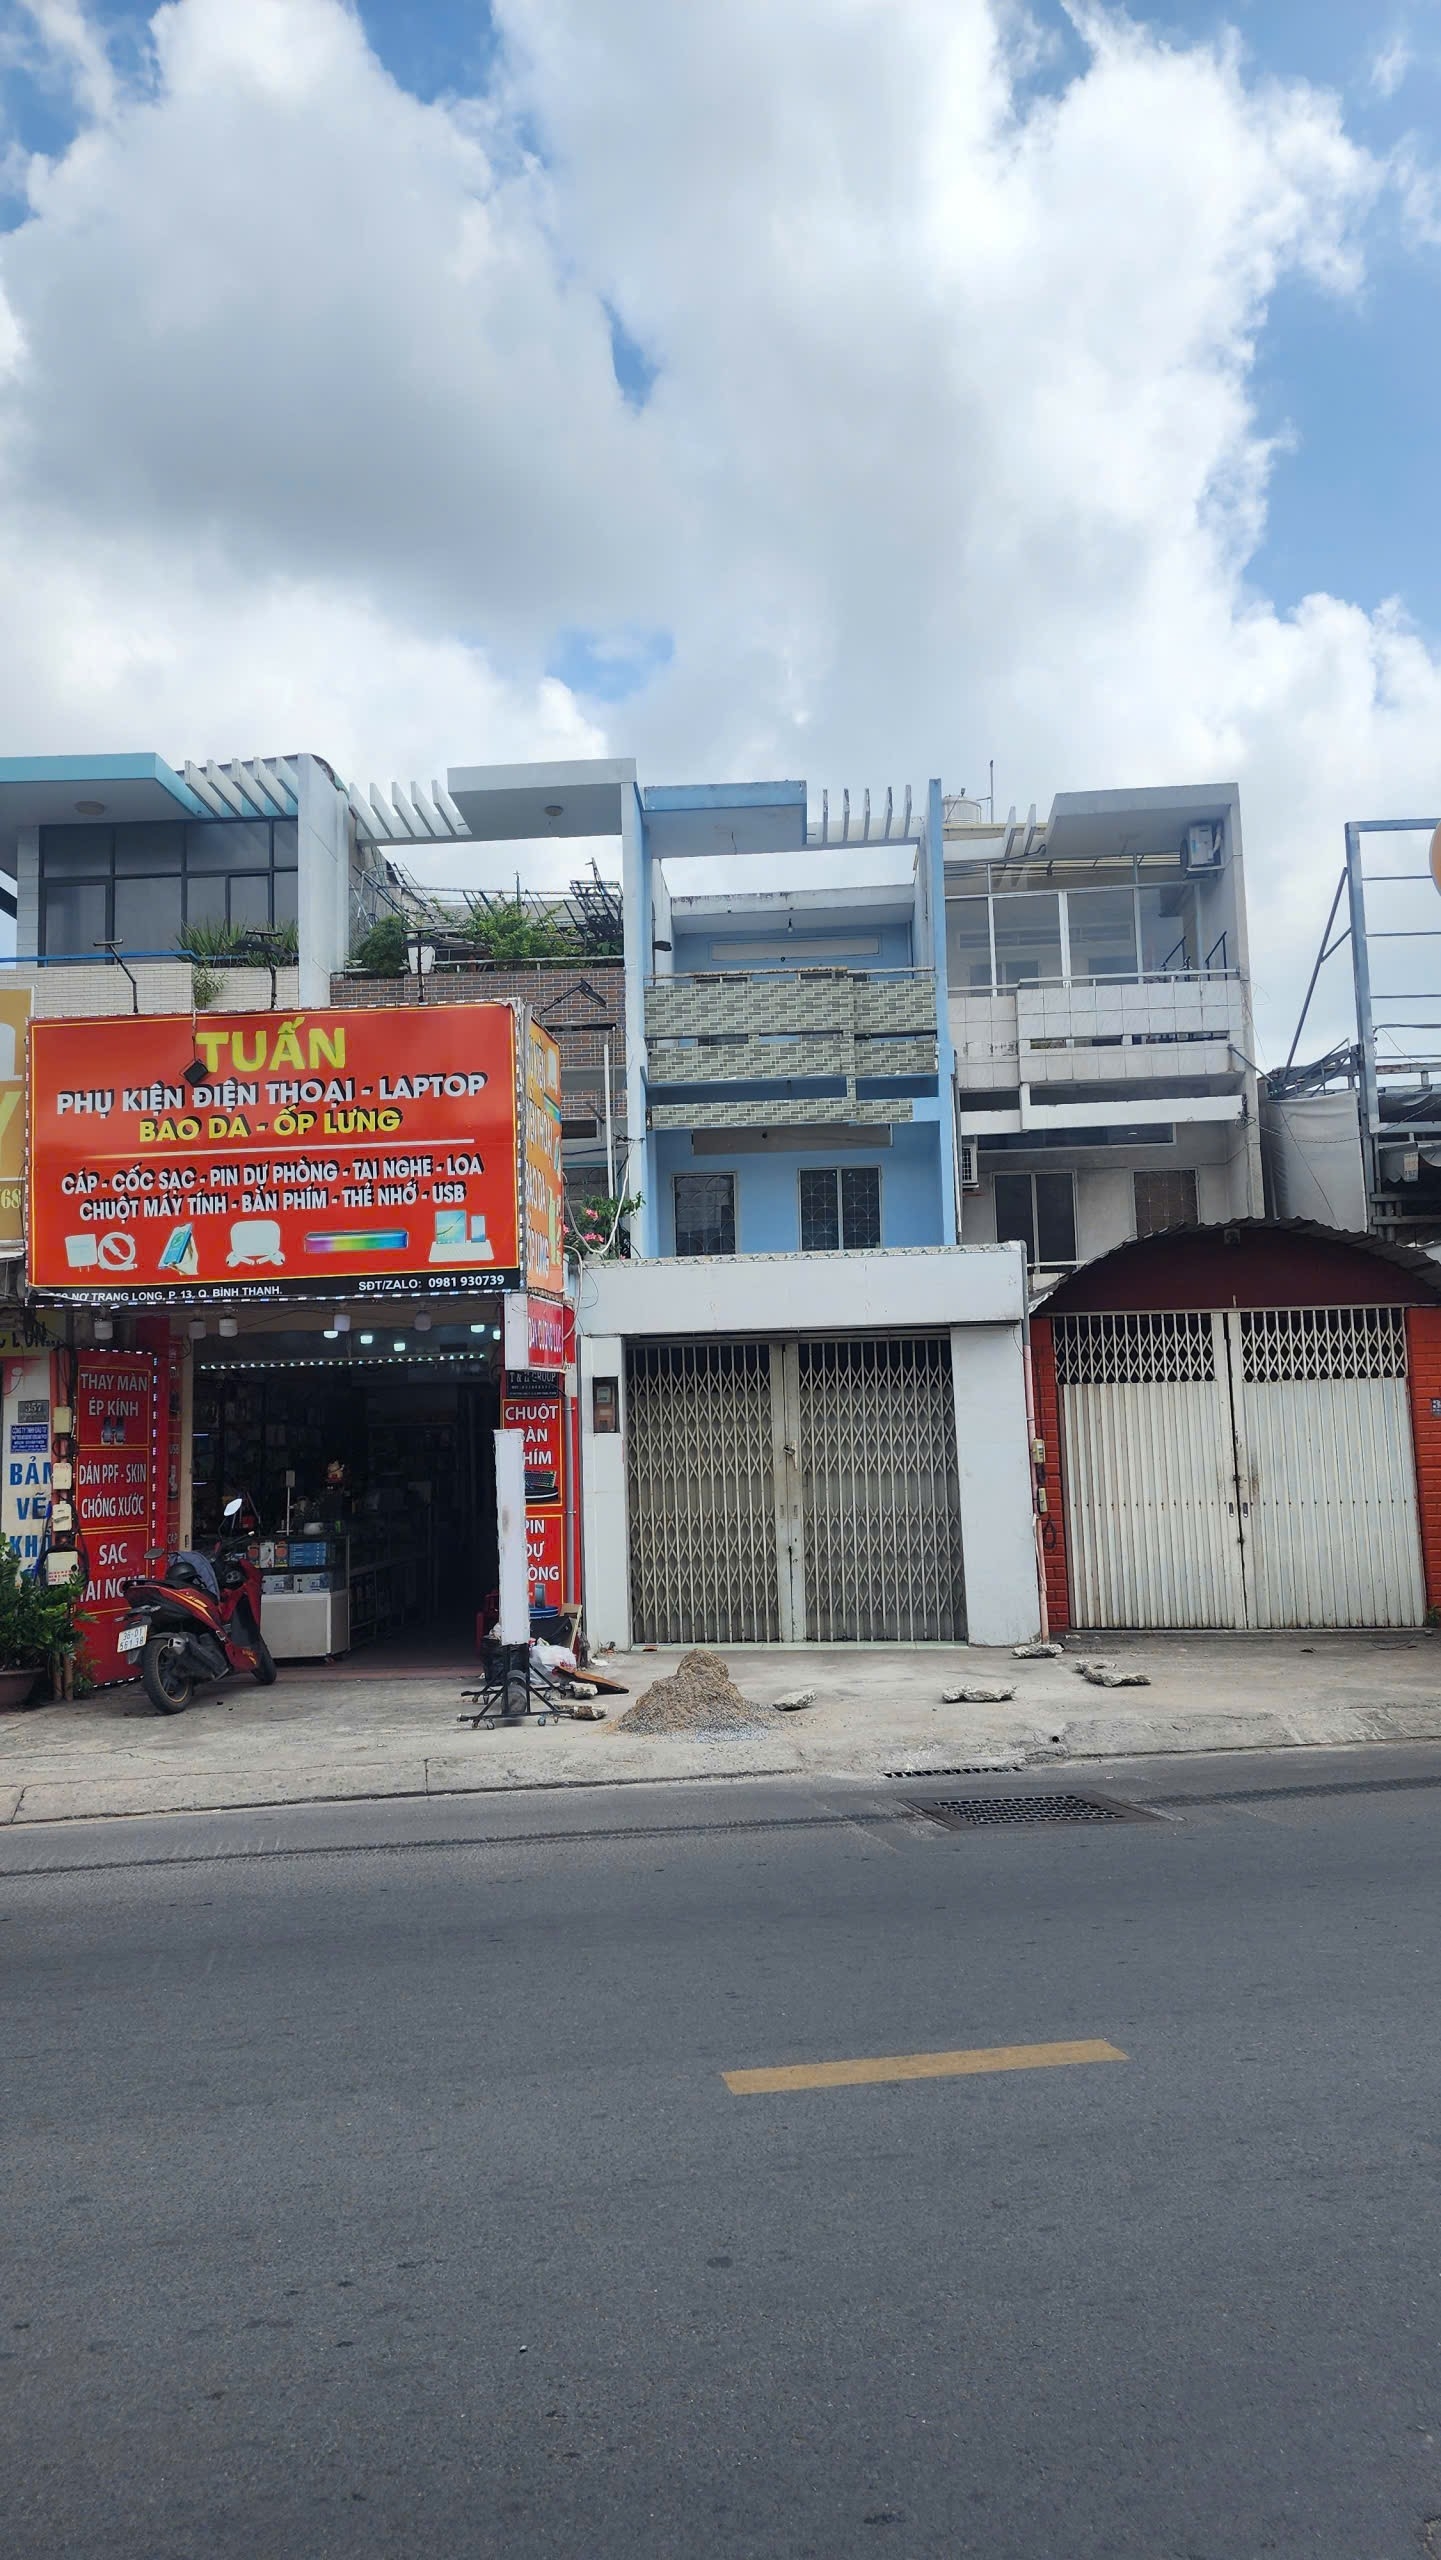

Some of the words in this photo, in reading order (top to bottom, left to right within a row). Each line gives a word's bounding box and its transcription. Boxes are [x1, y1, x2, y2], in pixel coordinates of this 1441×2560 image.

[195, 1017, 346, 1073] TUẤN
[57, 1091, 112, 1119] PHỤ
[122, 1083, 183, 1116] KIỆN
[192, 1079, 256, 1112] ĐIỆN
[265, 1080, 351, 1108] THOẠI
[379, 1074, 485, 1100] LAPTOP
[139, 1118, 200, 1142] BAO
[209, 1116, 249, 1139] DA
[273, 1105, 315, 1135] ỐP
[324, 1108, 401, 1134] LƯNG
[61, 1170, 98, 1195] CÁP
[111, 1165, 153, 1192] CỐC
[158, 1171, 195, 1194] SẠC
[210, 1167, 238, 1187] PIN
[244, 1165, 268, 1189] DỰ
[272, 1158, 338, 1184] PHÒNG
[352, 1161, 377, 1180] TAI
[383, 1158, 431, 1179] NGHE
[447, 1156, 483, 1176] LOA
[0, 1188, 21, 1209] 68
[79, 1194, 138, 1224] CHUỘT
[143, 1192, 182, 1217] MÁY
[188, 1192, 226, 1215] TÍNH
[241, 1186, 277, 1212] BÀN
[283, 1185, 327, 1210] PHÍM
[342, 1182, 372, 1208] THẺ
[377, 1180, 417, 1206] NHỚ
[432, 1184, 465, 1203] USB
[358, 1278, 422, 1291] SĐT/ZALO:
[428, 1277, 456, 1289] 0981
[460, 1274, 504, 1287] 930739
[91, 1291, 129, 1301] TRANG
[132, 1291, 165, 1301] LONG,
[198, 1289, 210, 1298] Q.
[213, 1287, 239, 1297] BÌNH
[81, 1373, 115, 1390] THAY
[117, 1372, 148, 1392] MÀN
[88, 1397, 104, 1416] ÉP
[107, 1398, 139, 1416] KÍNH
[505, 1402, 558, 1423] CHUỘT
[521, 1426, 548, 1443] ÀN
[523, 1448, 552, 1465] HÍM
[79, 1461, 100, 1485] DÁN
[102, 1464, 119, 1484] PPF
[126, 1463, 147, 1483] SKIN
[81, 1491, 116, 1519] CHỐNG
[118, 1491, 145, 1516] XƯỚC
[99, 1542, 128, 1570] SẠC
[528, 1564, 560, 1581] ÒNG
